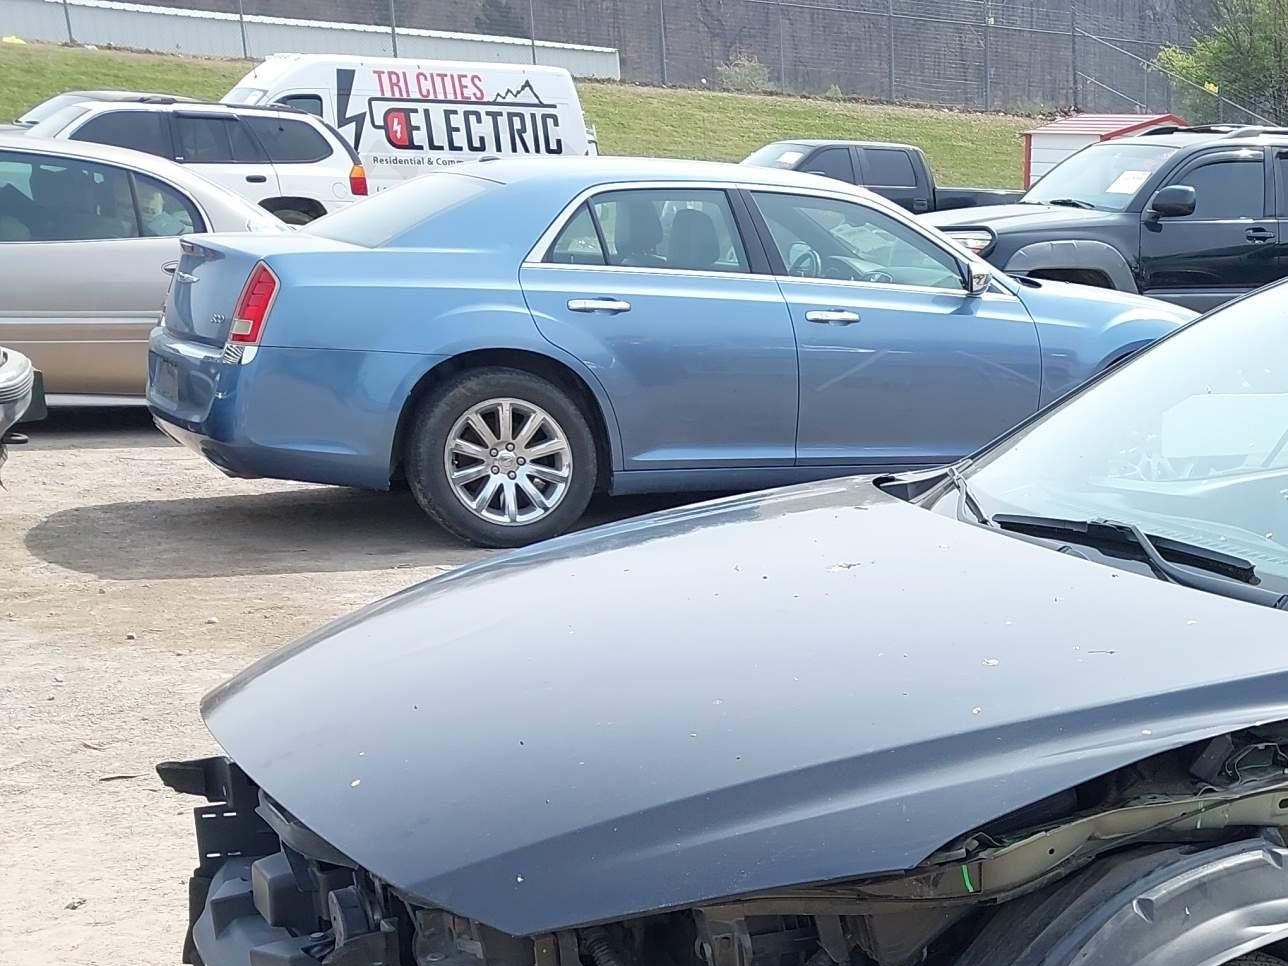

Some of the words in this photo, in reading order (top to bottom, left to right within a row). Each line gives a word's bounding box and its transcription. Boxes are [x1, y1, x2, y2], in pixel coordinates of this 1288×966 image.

[373, 70, 411, 97] TRI
[416, 72, 485, 101] CITIES
[404, 107, 563, 155] ELECTRIC
[372, 155, 425, 166] Residential
[427, 157, 434, 166] &
